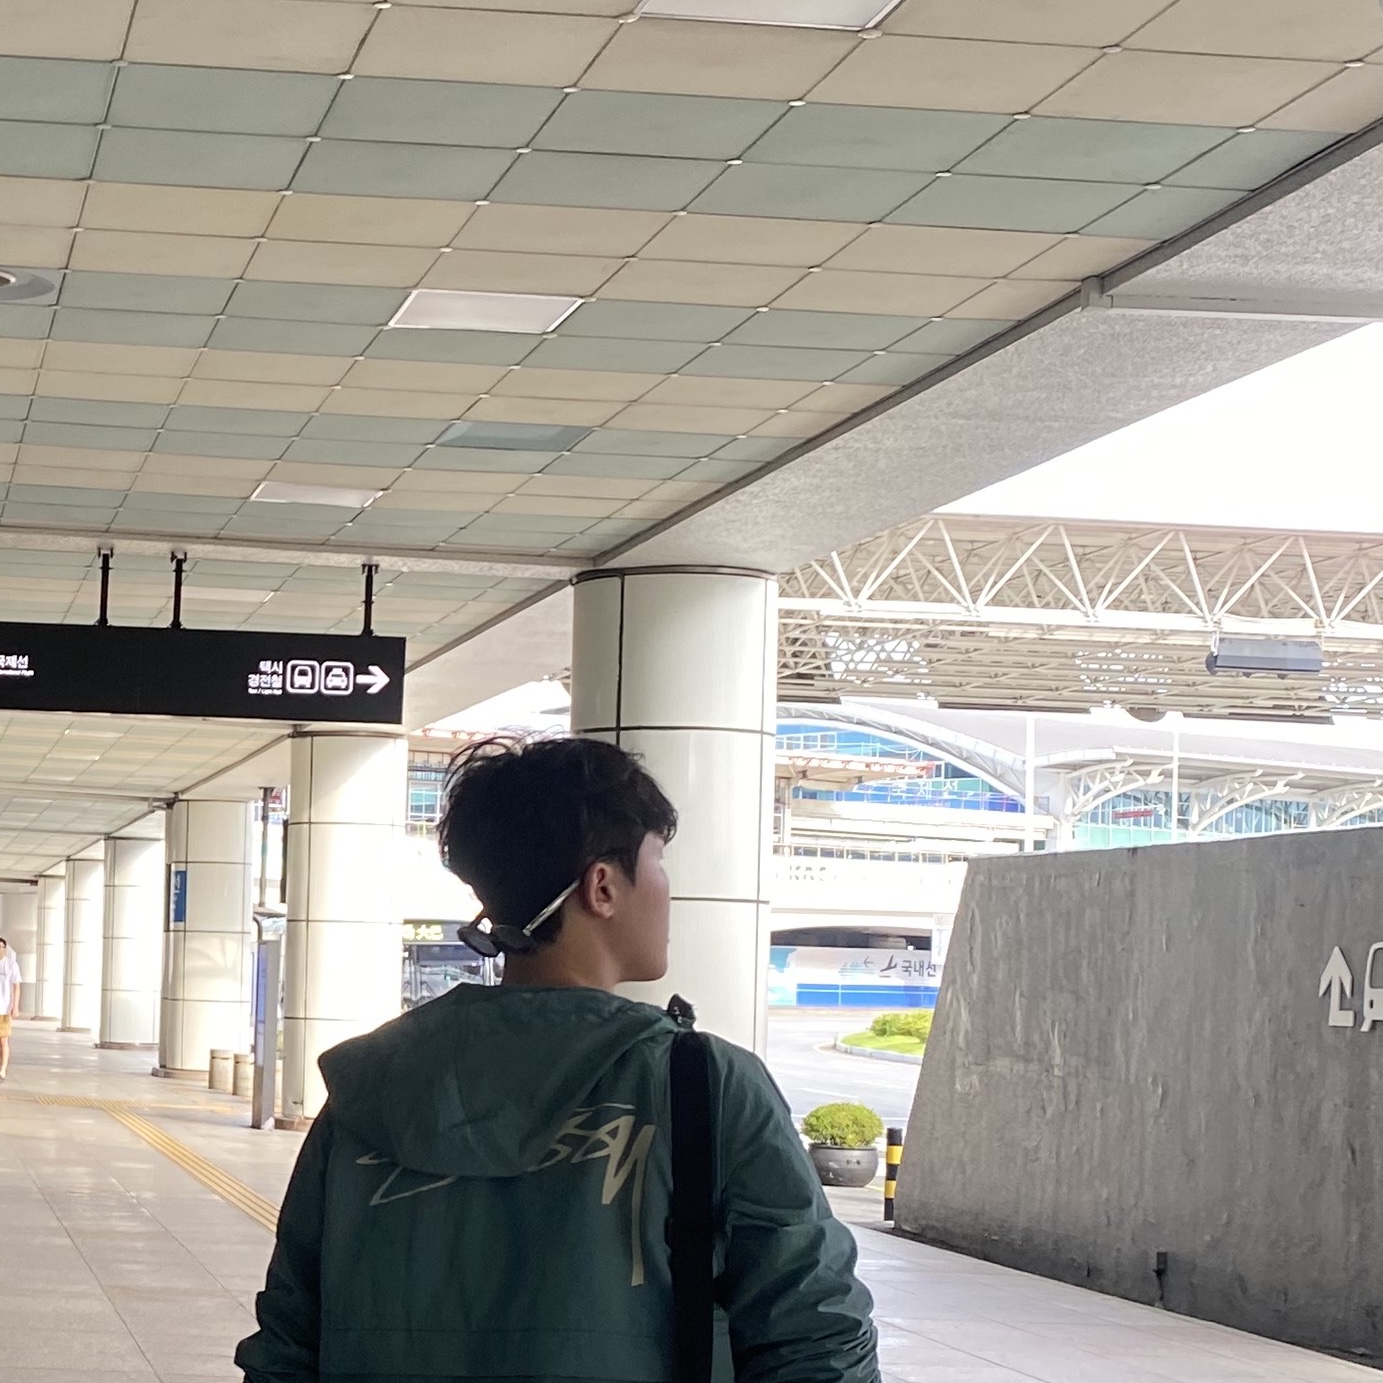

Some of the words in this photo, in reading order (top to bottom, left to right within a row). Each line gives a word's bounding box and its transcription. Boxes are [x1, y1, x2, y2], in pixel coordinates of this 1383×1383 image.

[259, 661, 283, 674] 택시
[248, 674, 283, 687] 경전철
[901, 959, 937, 978] 국내선
